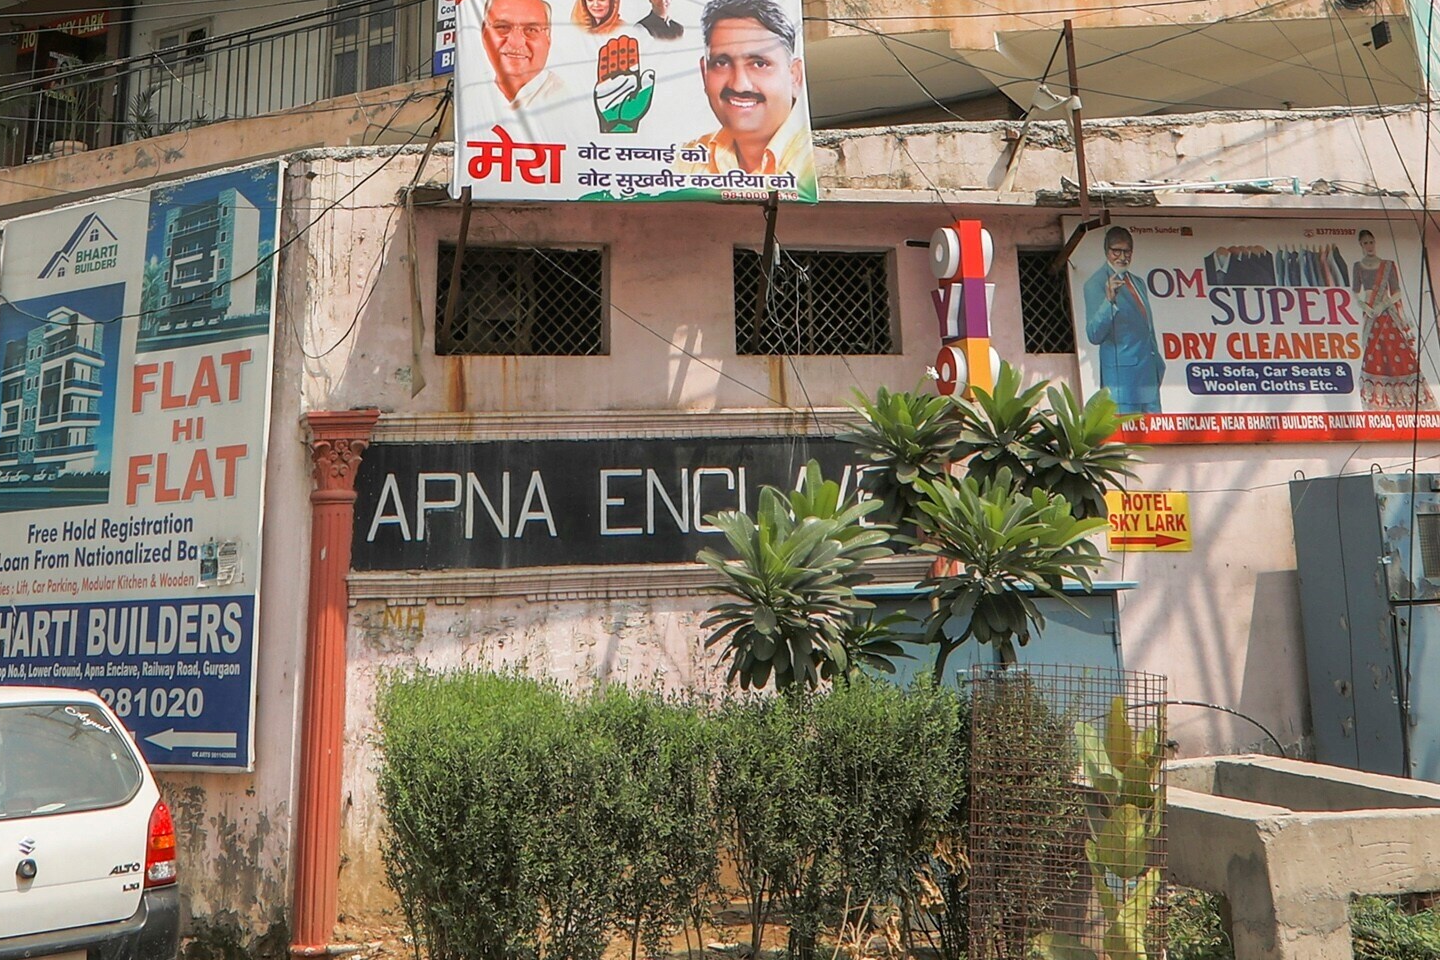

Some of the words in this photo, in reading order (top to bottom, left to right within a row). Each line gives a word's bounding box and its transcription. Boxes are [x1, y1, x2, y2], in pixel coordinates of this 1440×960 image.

[78, 13, 105, 35] LARK
[467, 125, 566, 185] मेरा
[578, 142, 611, 162] वोट
[615, 143, 676, 163] सच्चाई
[681, 144, 707, 163] को
[578, 168, 611, 187] वोट
[616, 168, 685, 195] सुखबीर
[691, 170, 765, 188] कटारिया
[771, 171, 796, 188] को
[1130, 226, 1153, 235] Shyam
[1155, 226, 1179, 235] Sunder
[75, 244, 118, 264] BHARTI
[75, 257, 117, 275] BUILDERS
[1147, 268, 1207, 299] OM
[929, 226, 968, 397] OYO
[1210, 287, 1359, 326] SUPER
[1163, 332, 1216, 361] DRY
[1226, 331, 1361, 360] CLEANERS
[132, 349, 252, 414] FLAT
[1191, 365, 1218, 381] Spl.
[1223, 365, 1259, 381] Sofa,
[1262, 365, 1289, 378] Car
[1291, 365, 1331, 378] Seats
[1335, 365, 1346, 378] &
[1204, 379, 1257, 392] Woolen
[1260, 379, 1307, 392] Cloths
[1310, 379, 1338, 391] Etc.
[172, 416, 204, 442] HI
[1150, 416, 1175, 431] APNA
[1176, 416, 1220, 433] ENCLAVE,
[1221, 415, 1246, 430] NEAR
[1247, 415, 1280, 430] BHARTI
[1282, 414, 1327, 431] BUILDERS,
[1328, 414, 1366, 429] RAILWAY
[1368, 414, 1395, 431] ROAD,
[126, 444, 248, 506] FLAT
[367, 469, 558, 542] APNA
[600, 465, 876, 536] ENCLE
[1121, 494, 1172, 512] HOTEL
[28, 524, 58, 544] Free
[63, 518, 96, 541] Hold
[101, 513, 193, 542] Registration
[1109, 514, 1143, 533] SKY
[1146, 514, 1187, 532] LARK
[34, 549, 69, 569] From
[74, 540, 172, 567] Nationalized
[178, 540, 198, 561] Ba
[16, 580, 30, 596] Lift,
[32, 580, 46, 594] Car
[47, 578, 80, 595] Parking,
[81, 576, 115, 592] Modular
[117, 574, 148, 590] Kitchen
[151, 574, 157, 588] &
[160, 571, 194, 588] Wooden
[86, 602, 242, 657] BUILDERS
[28, 663, 52, 678] Lower
[53, 662, 83, 680] Ground,
[84, 662, 105, 680] Apna
[106, 661, 140, 679] Enclave,
[142, 660, 175, 679] Railway
[176, 660, 201, 677] Road,
[203, 660, 240, 679] Gurgaon
[98, 687, 204, 718] 281020
[109, 862, 140, 875] ALTO
